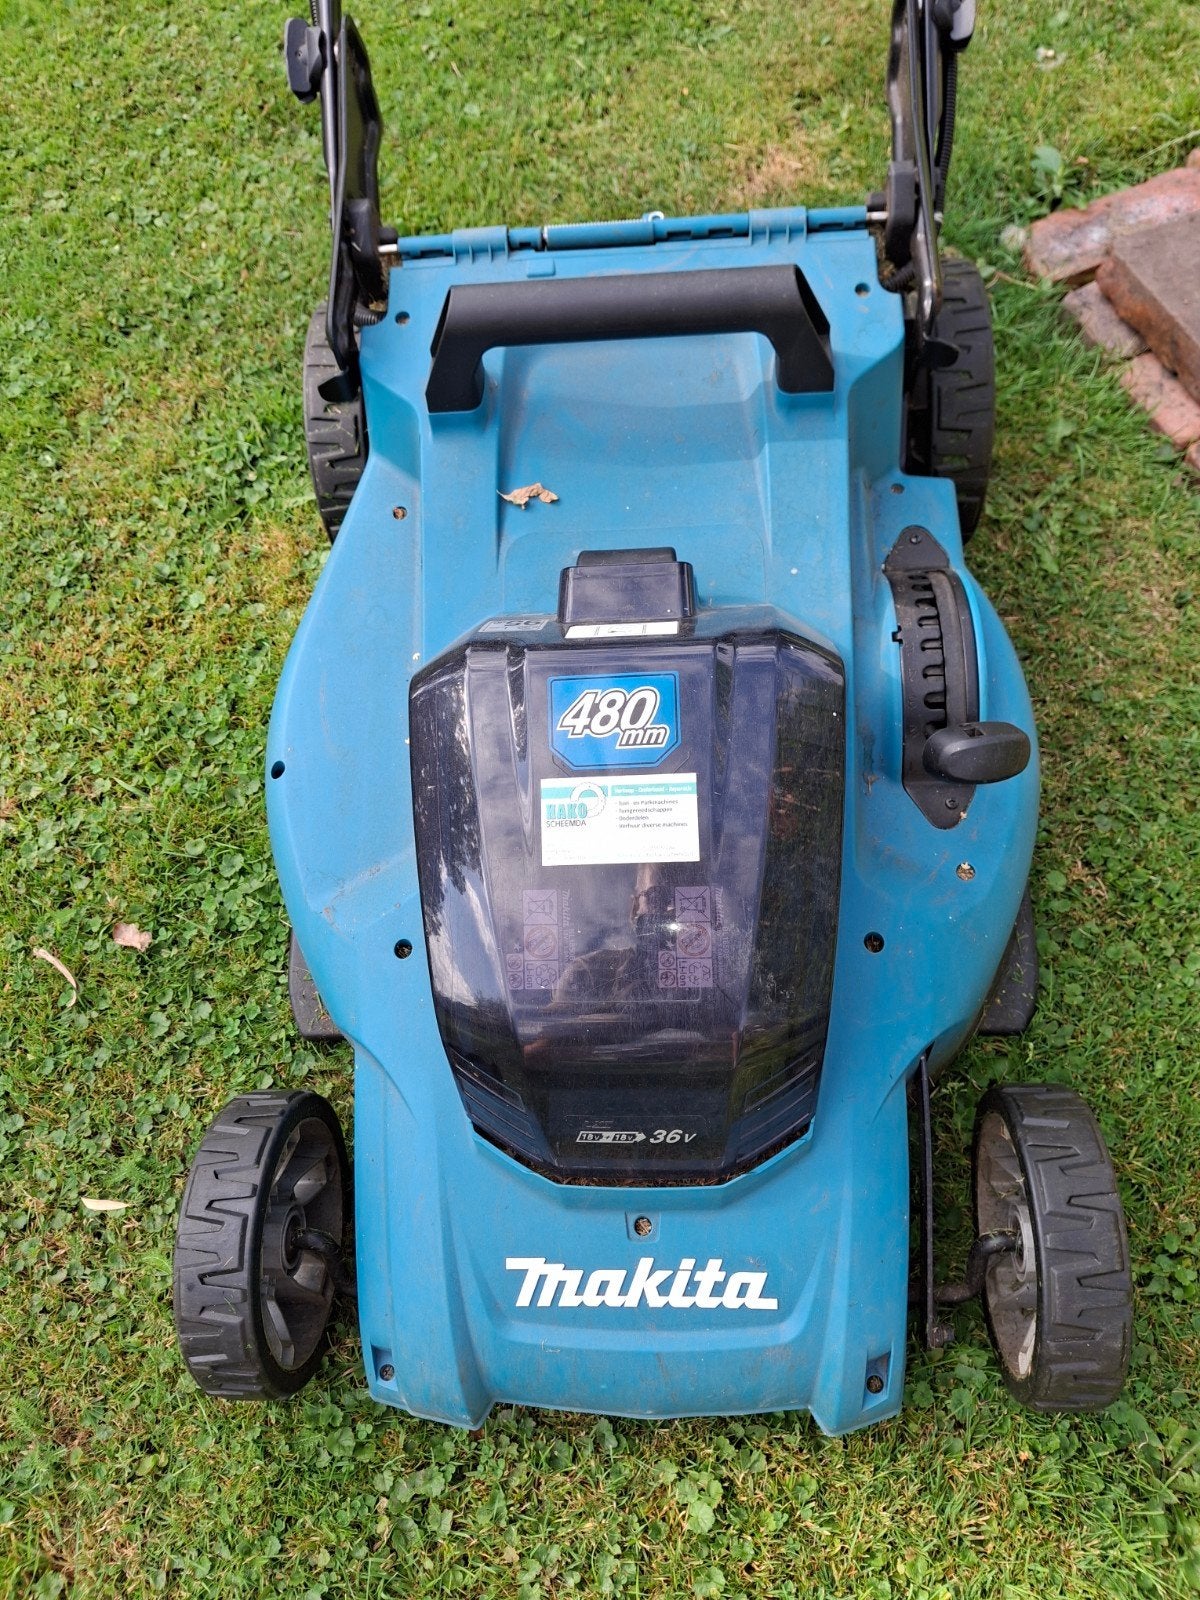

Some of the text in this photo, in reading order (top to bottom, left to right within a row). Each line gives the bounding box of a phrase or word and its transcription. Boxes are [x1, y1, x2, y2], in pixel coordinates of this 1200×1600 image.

[558, 687, 660, 738] 480
[617, 725, 669, 749] mm
[546, 803, 588, 819] HAKO
[546, 819, 587, 828] SCHEEMDA
[663, 820, 688, 828] machines
